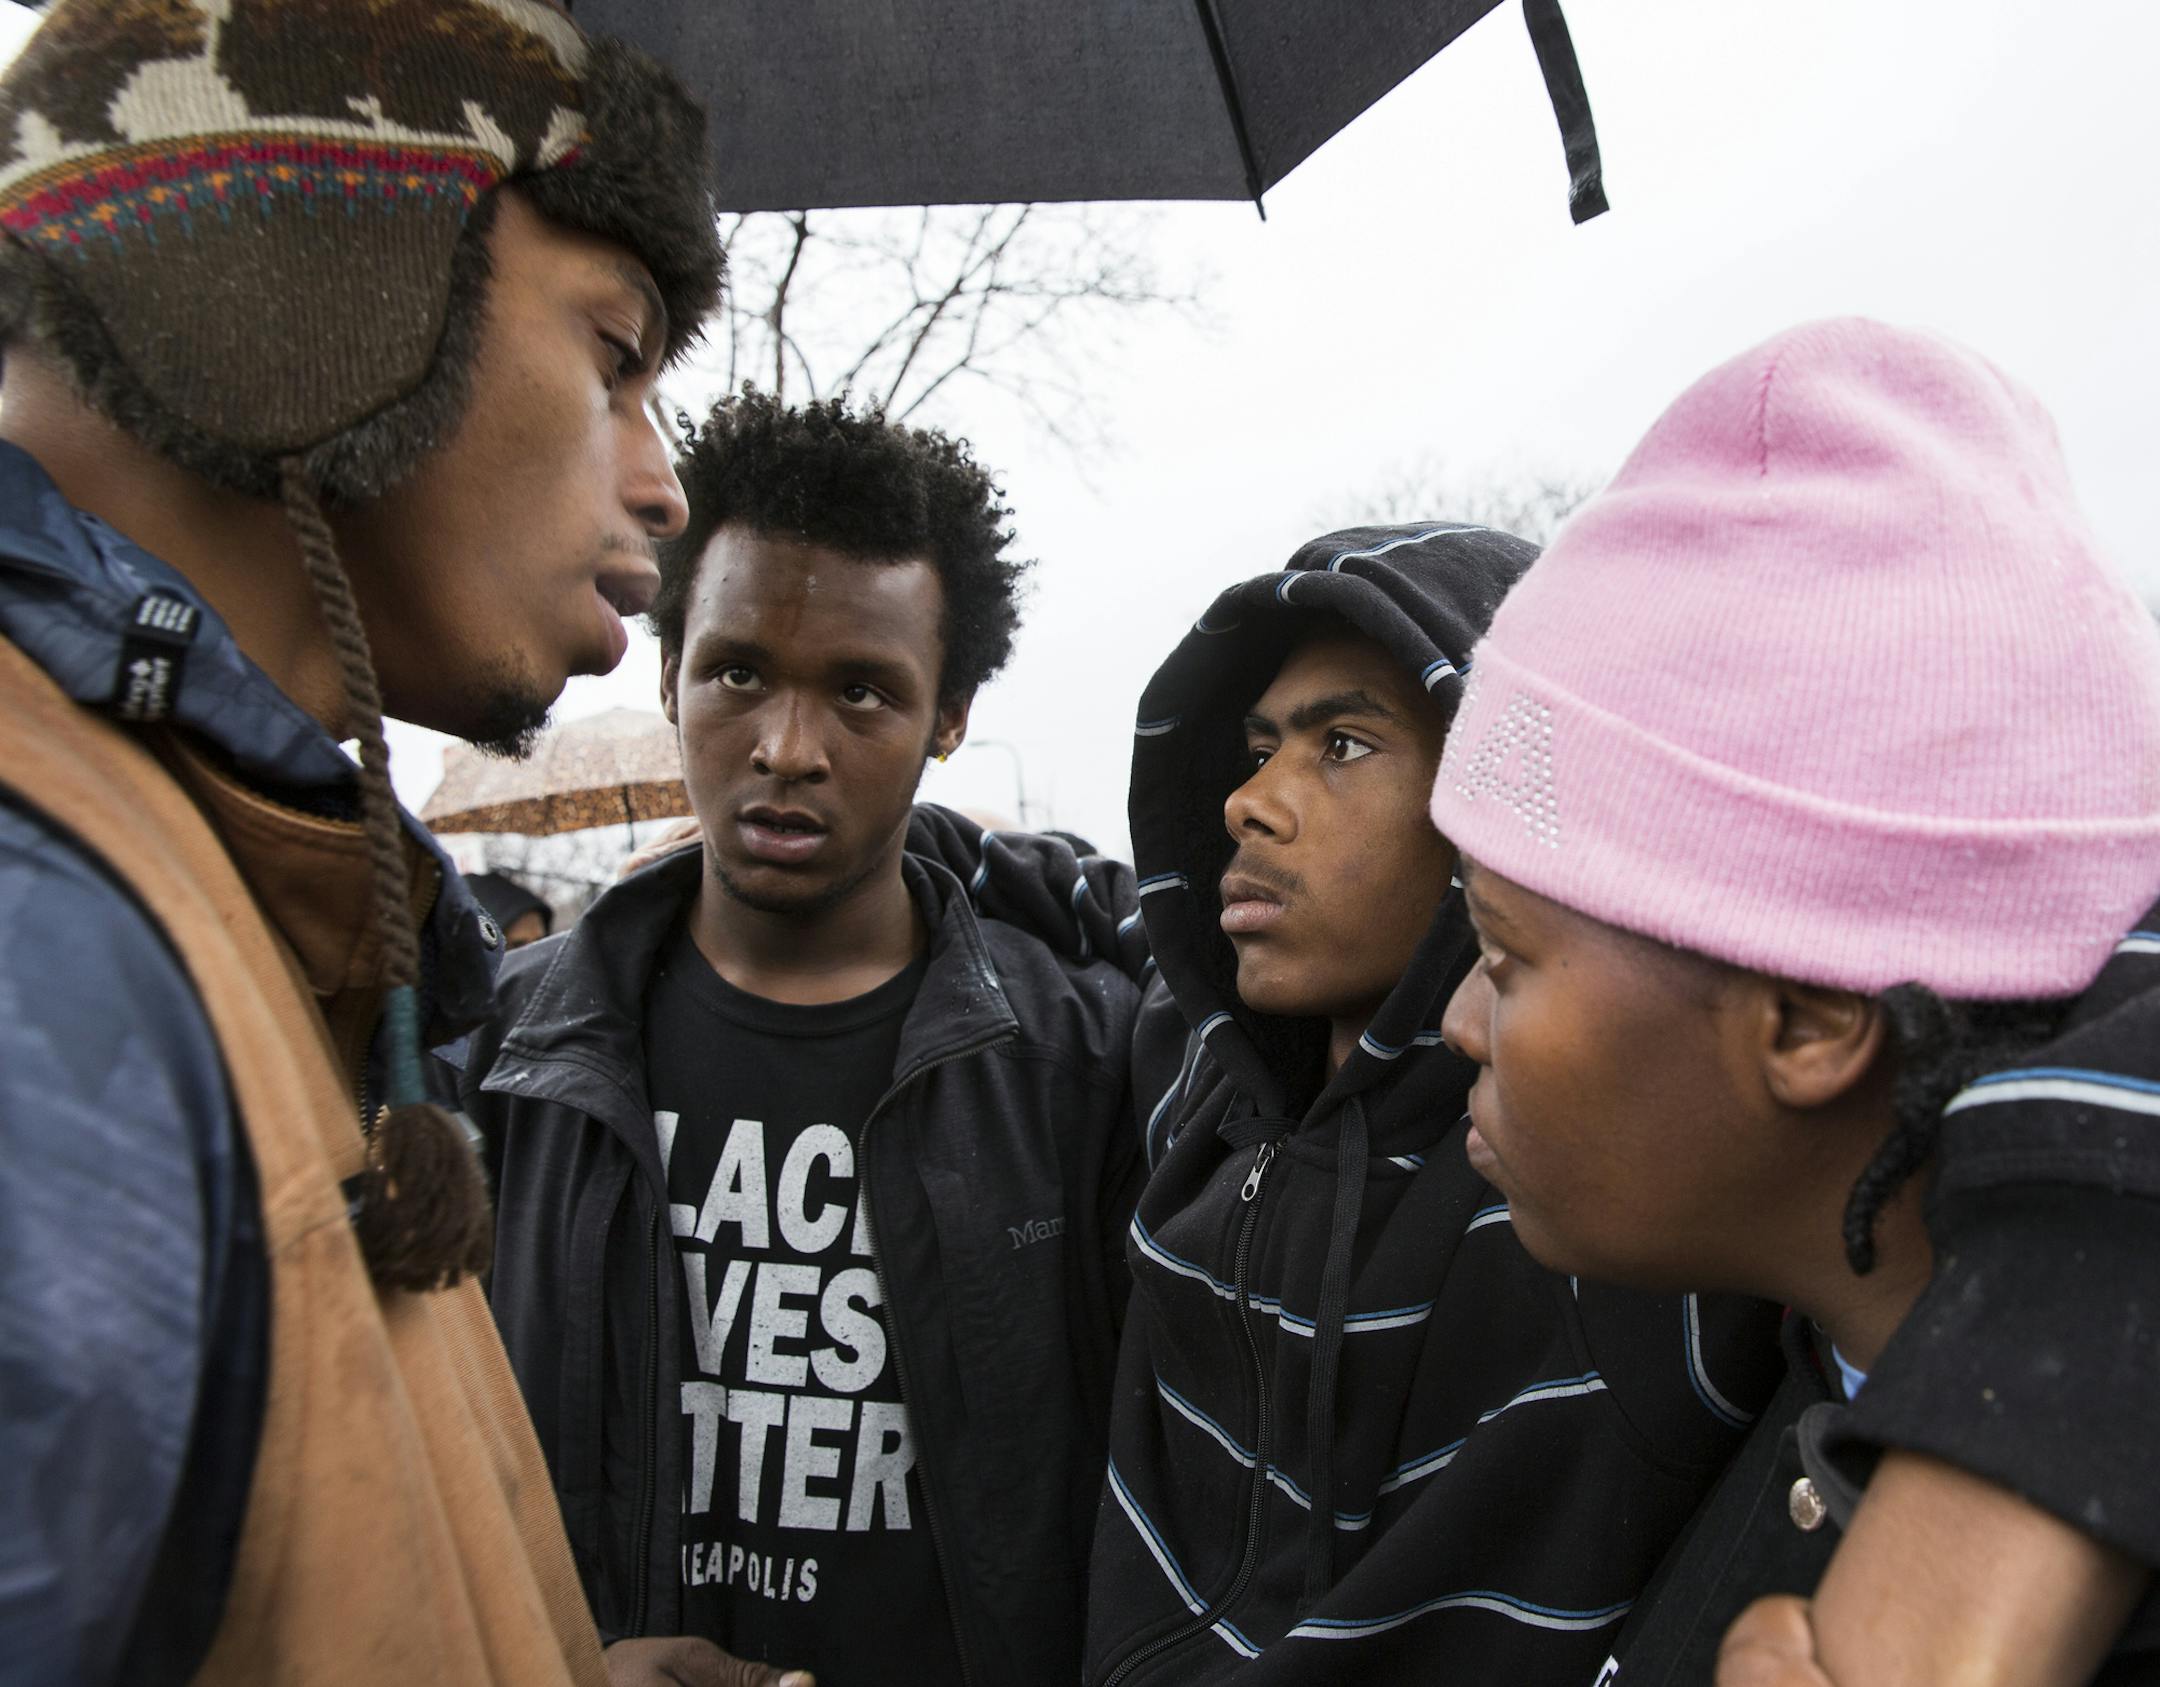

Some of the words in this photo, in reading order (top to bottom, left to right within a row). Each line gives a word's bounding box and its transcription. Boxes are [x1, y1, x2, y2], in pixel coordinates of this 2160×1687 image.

[1446, 672, 1560, 849] A
[680, 1381, 915, 1531] TTER
[682, 1542, 819, 1602] EAPOLIS
